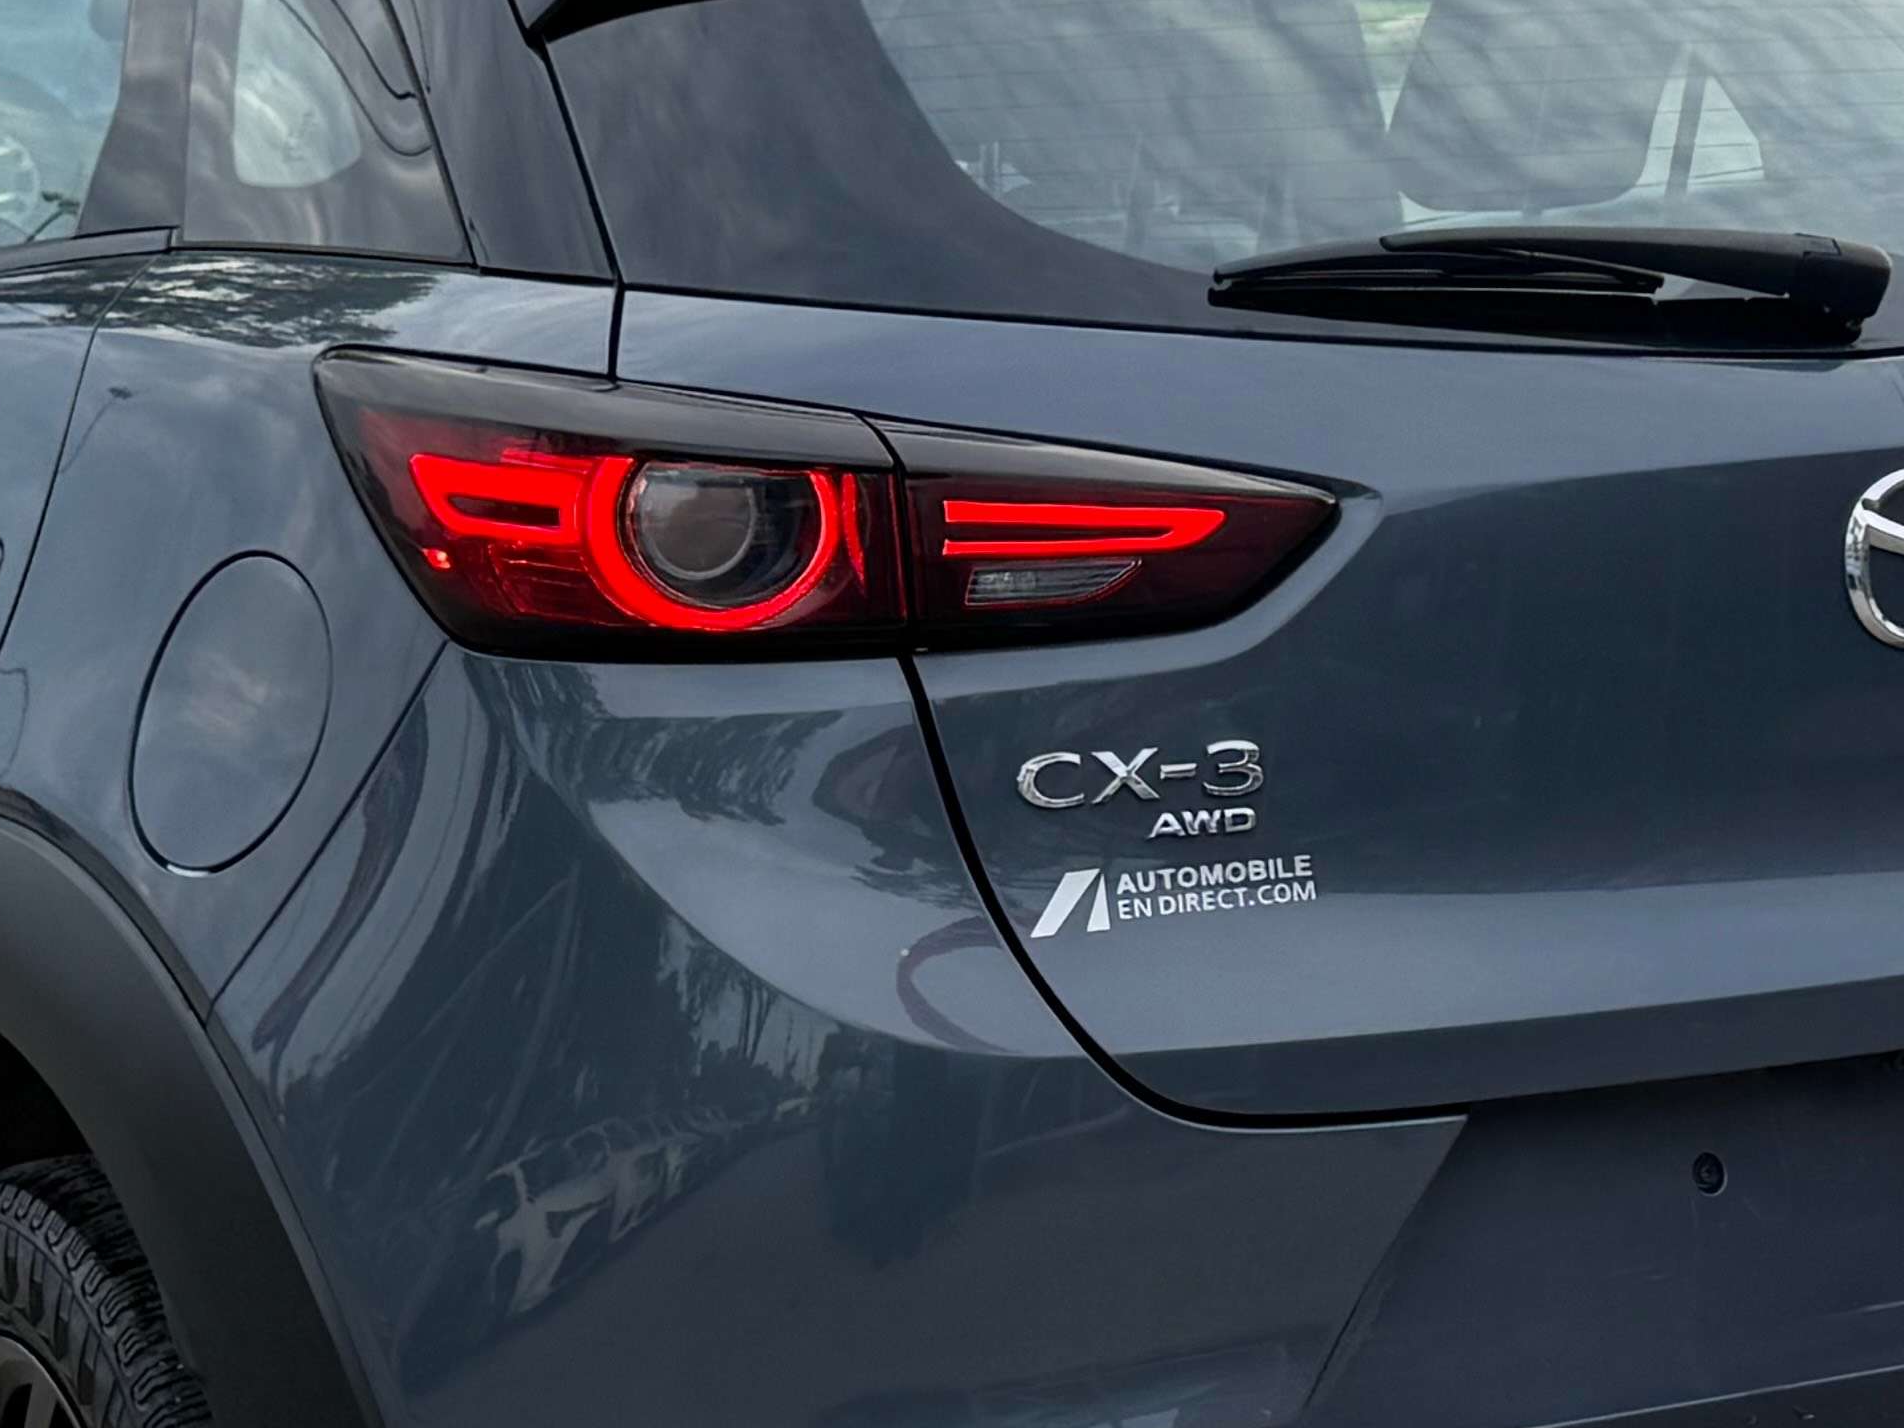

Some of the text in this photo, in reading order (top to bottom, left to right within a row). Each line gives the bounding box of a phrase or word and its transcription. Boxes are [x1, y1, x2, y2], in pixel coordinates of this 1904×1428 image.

[1016, 739, 1264, 809] CX-3
[1146, 806, 1256, 839] AWD
[1116, 854, 1314, 895] AUTOMOBILE
[1117, 880, 1317, 920] EN DIRECT.COM
